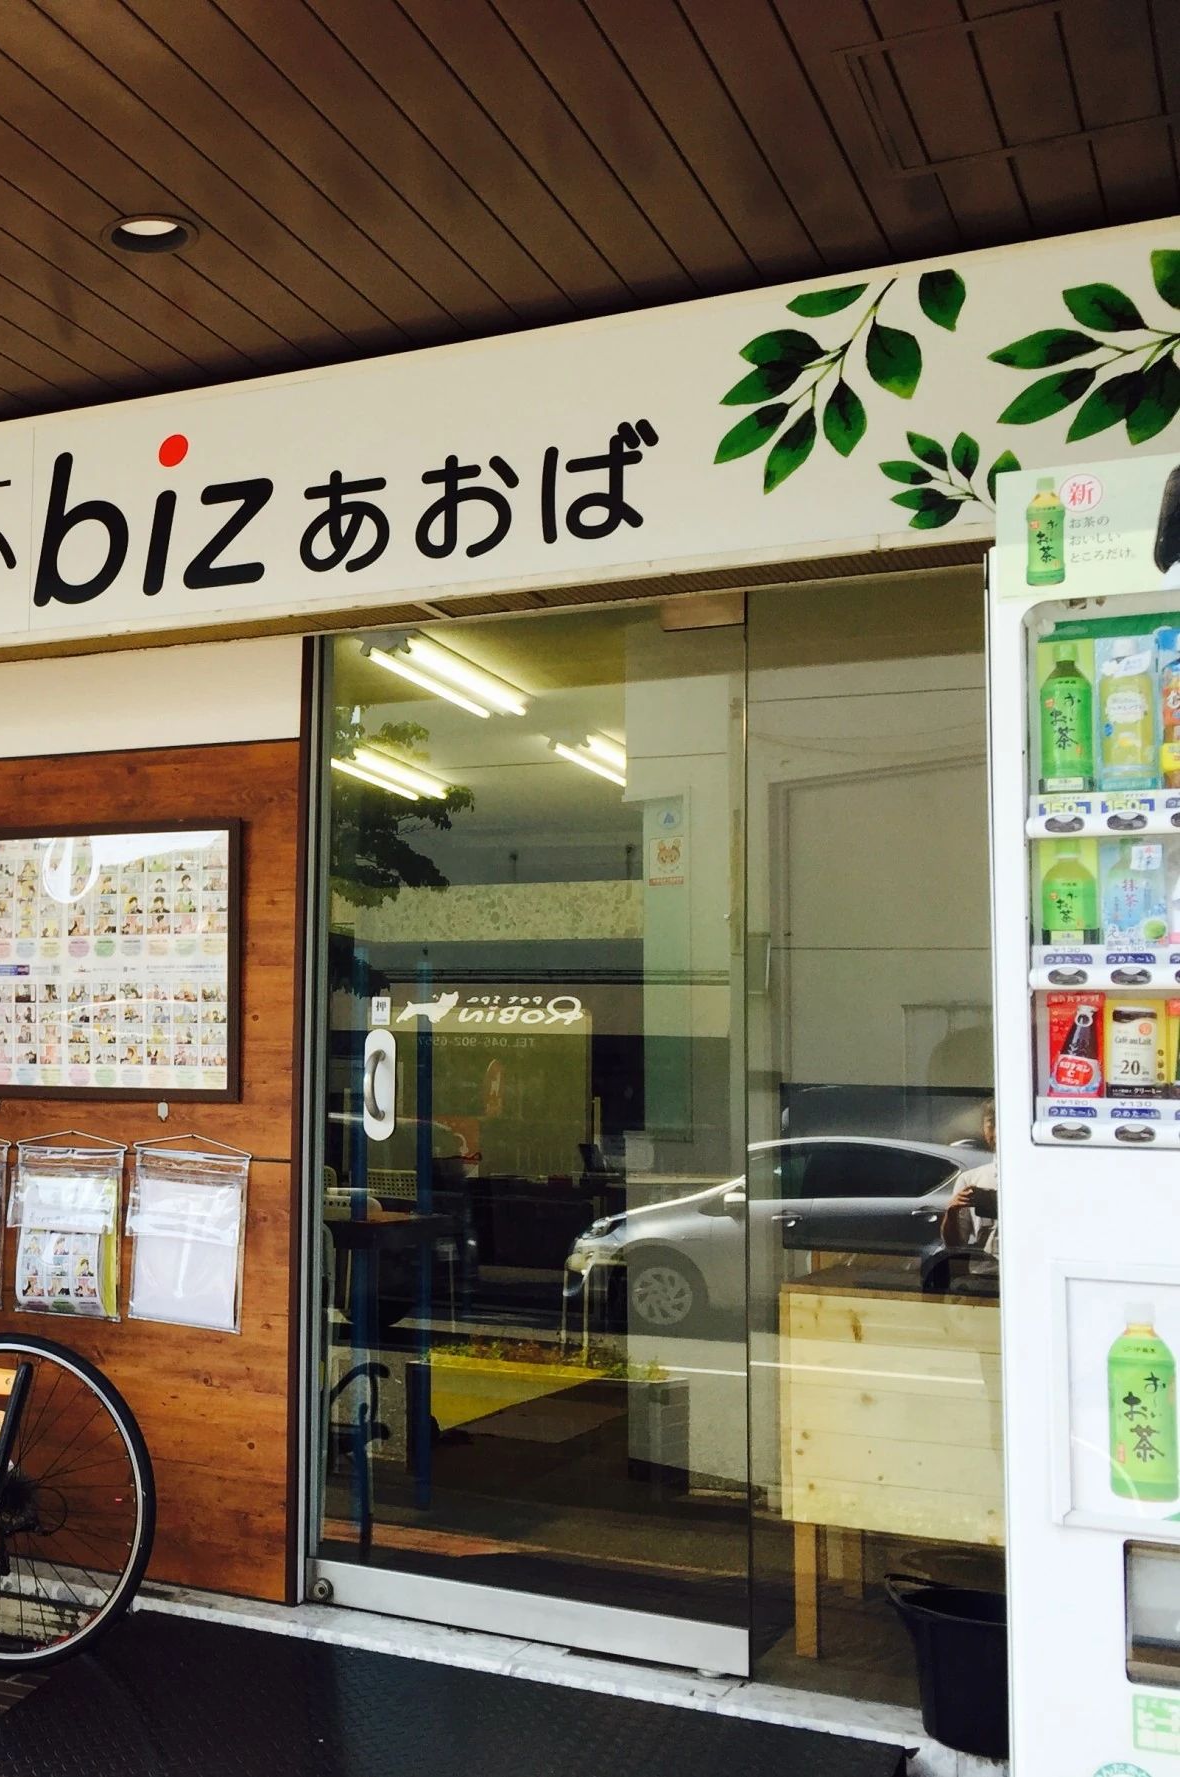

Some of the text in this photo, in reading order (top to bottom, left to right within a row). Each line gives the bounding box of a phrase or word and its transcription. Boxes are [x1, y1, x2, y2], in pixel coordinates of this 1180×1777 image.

[1069, 481, 1094, 506] 新
[33, 433, 273, 606] biz
[299, 418, 659, 573] あおば
[1069, 516, 1110, 529] お茶の
[1120, 1060, 1140, 1076] 20
